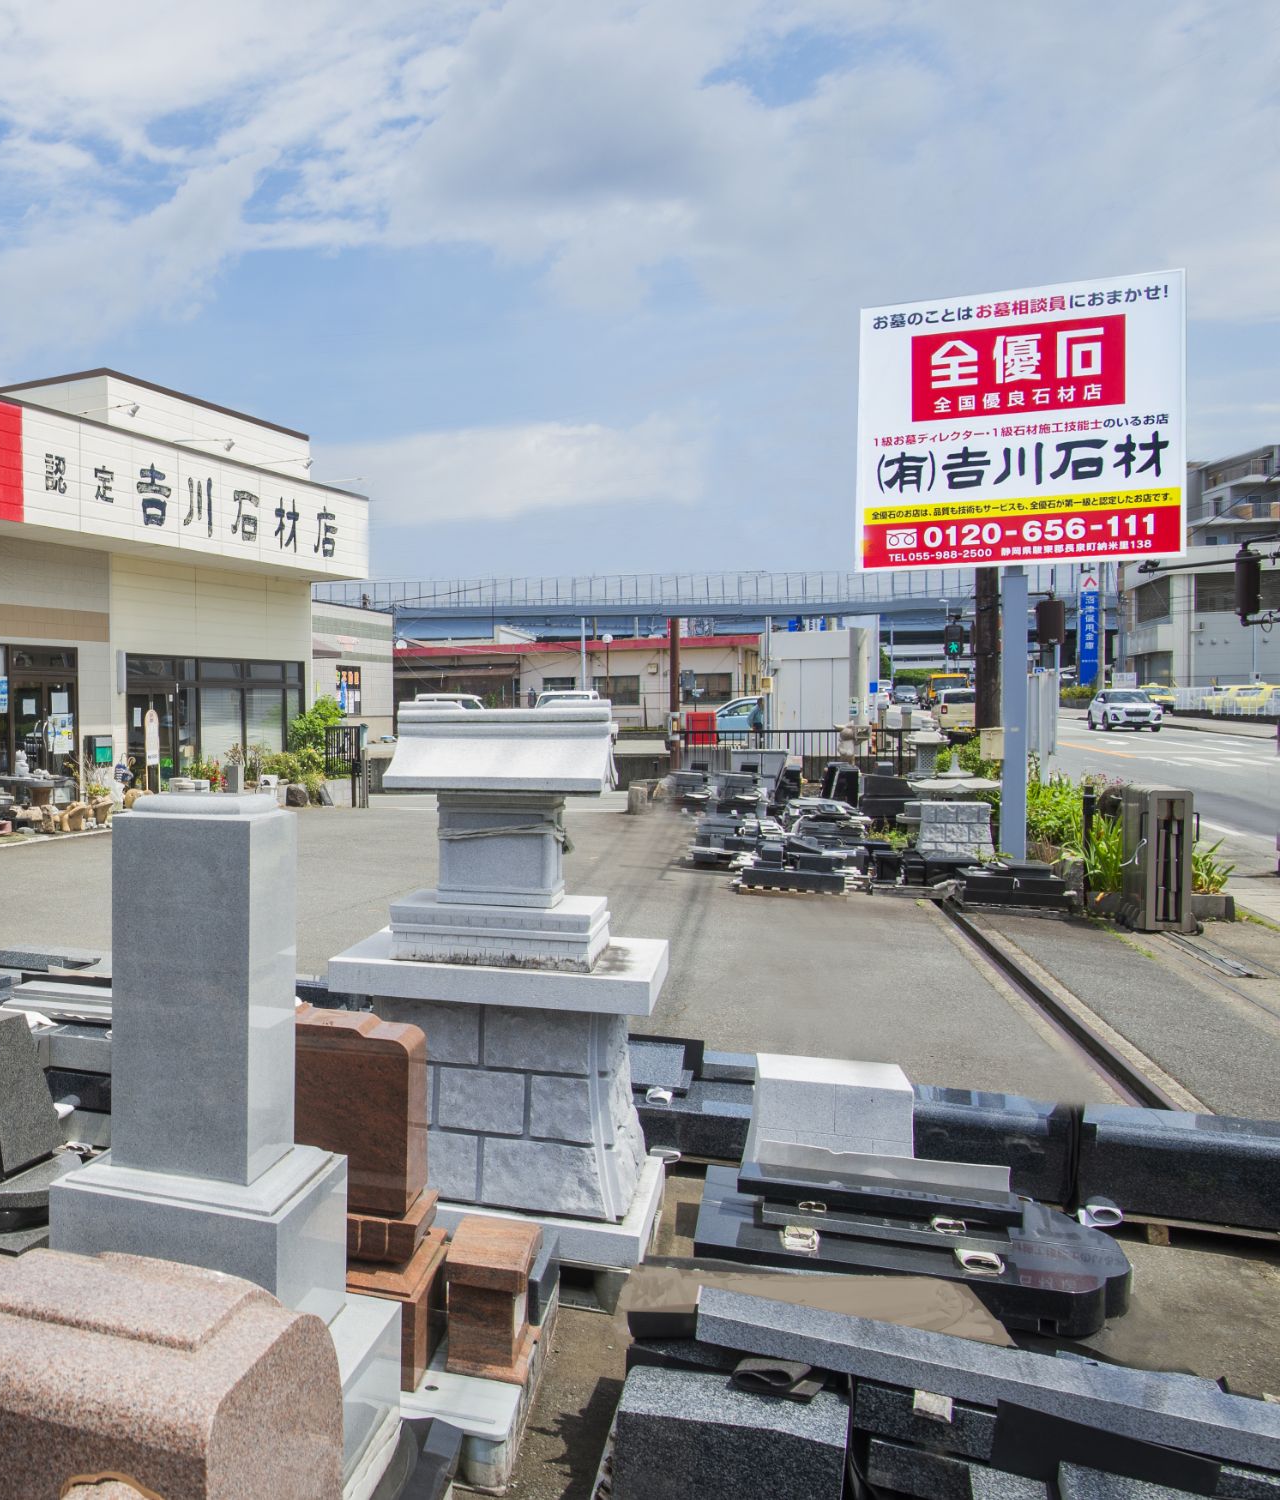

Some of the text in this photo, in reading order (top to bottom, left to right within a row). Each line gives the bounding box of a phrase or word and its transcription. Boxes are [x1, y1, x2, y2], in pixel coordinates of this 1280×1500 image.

[931, 327, 1104, 389] 全優石
[933, 383, 1102, 414] 全国優良石材店
[923, 513, 1155, 548] 0120-656-111
